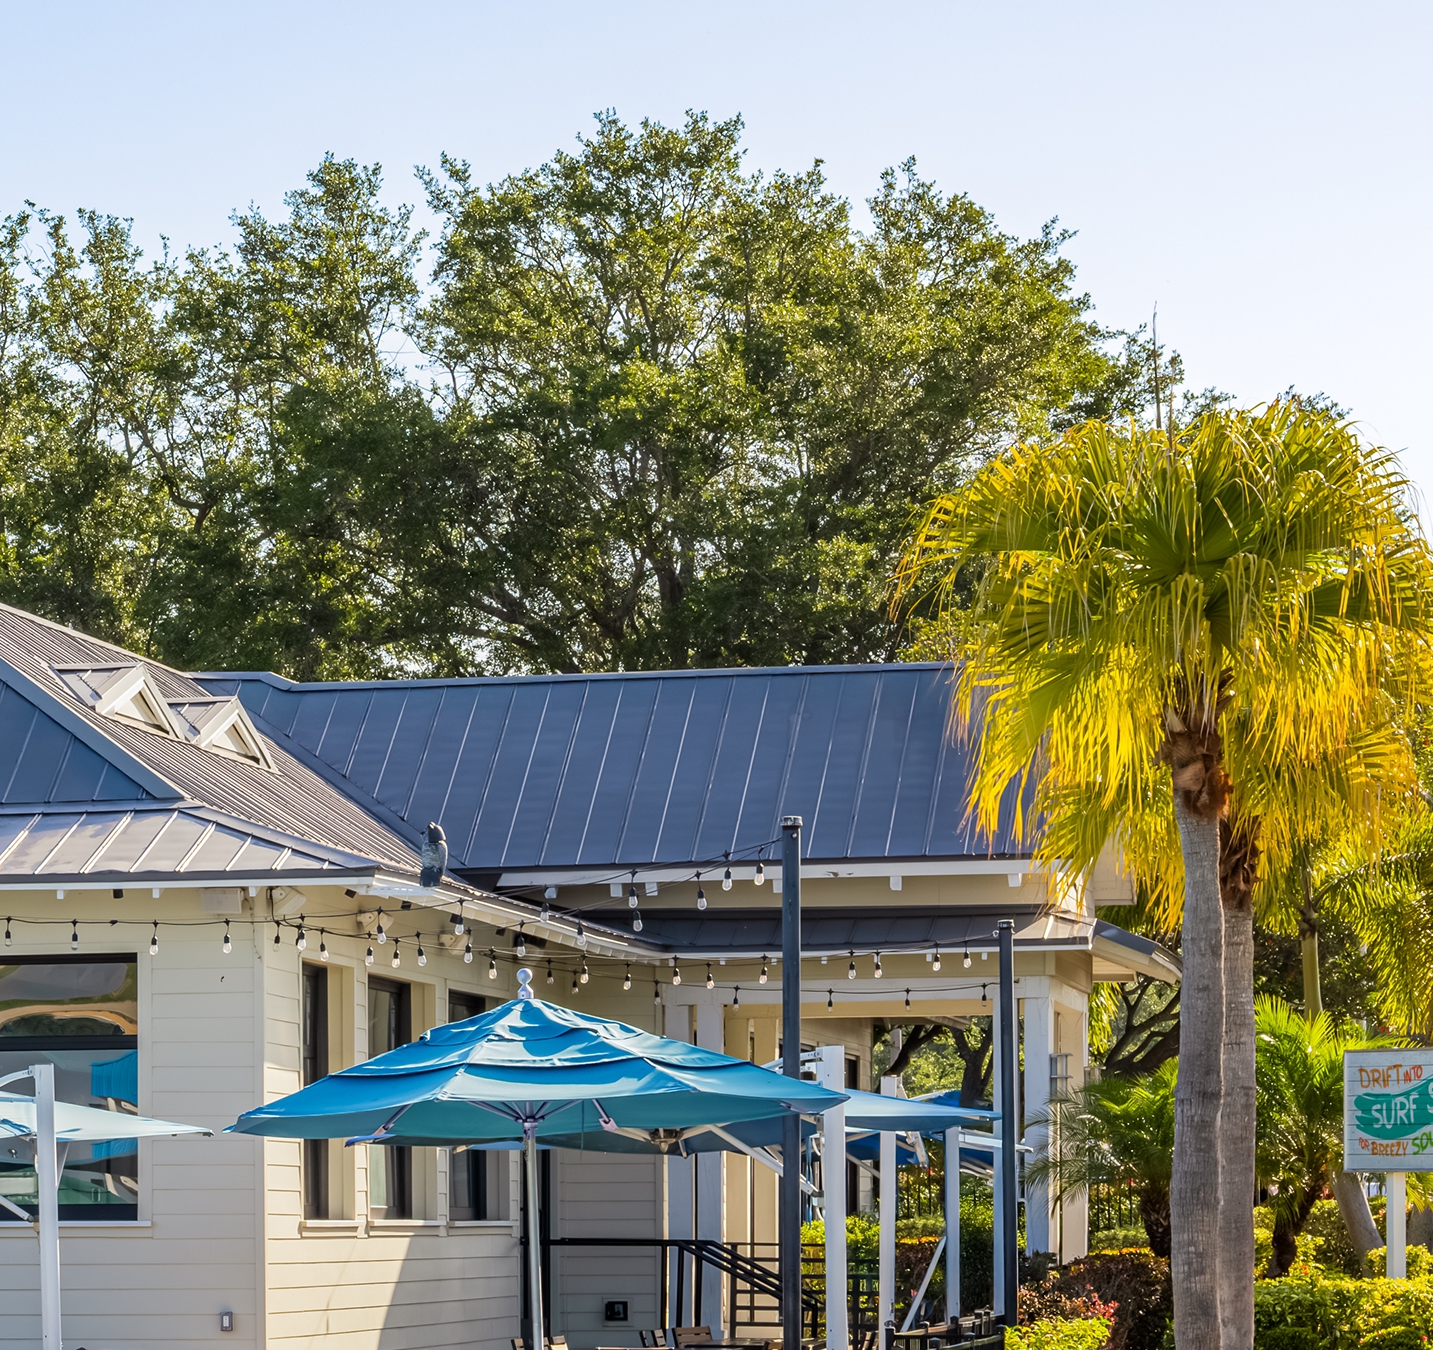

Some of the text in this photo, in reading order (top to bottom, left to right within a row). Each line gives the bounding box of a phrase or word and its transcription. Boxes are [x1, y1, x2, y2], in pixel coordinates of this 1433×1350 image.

[1358, 1063, 1423, 1089] DRIFT INTO
[1371, 1092, 1419, 1129] SURF
[1371, 1141, 1409, 1157] BREEZY
